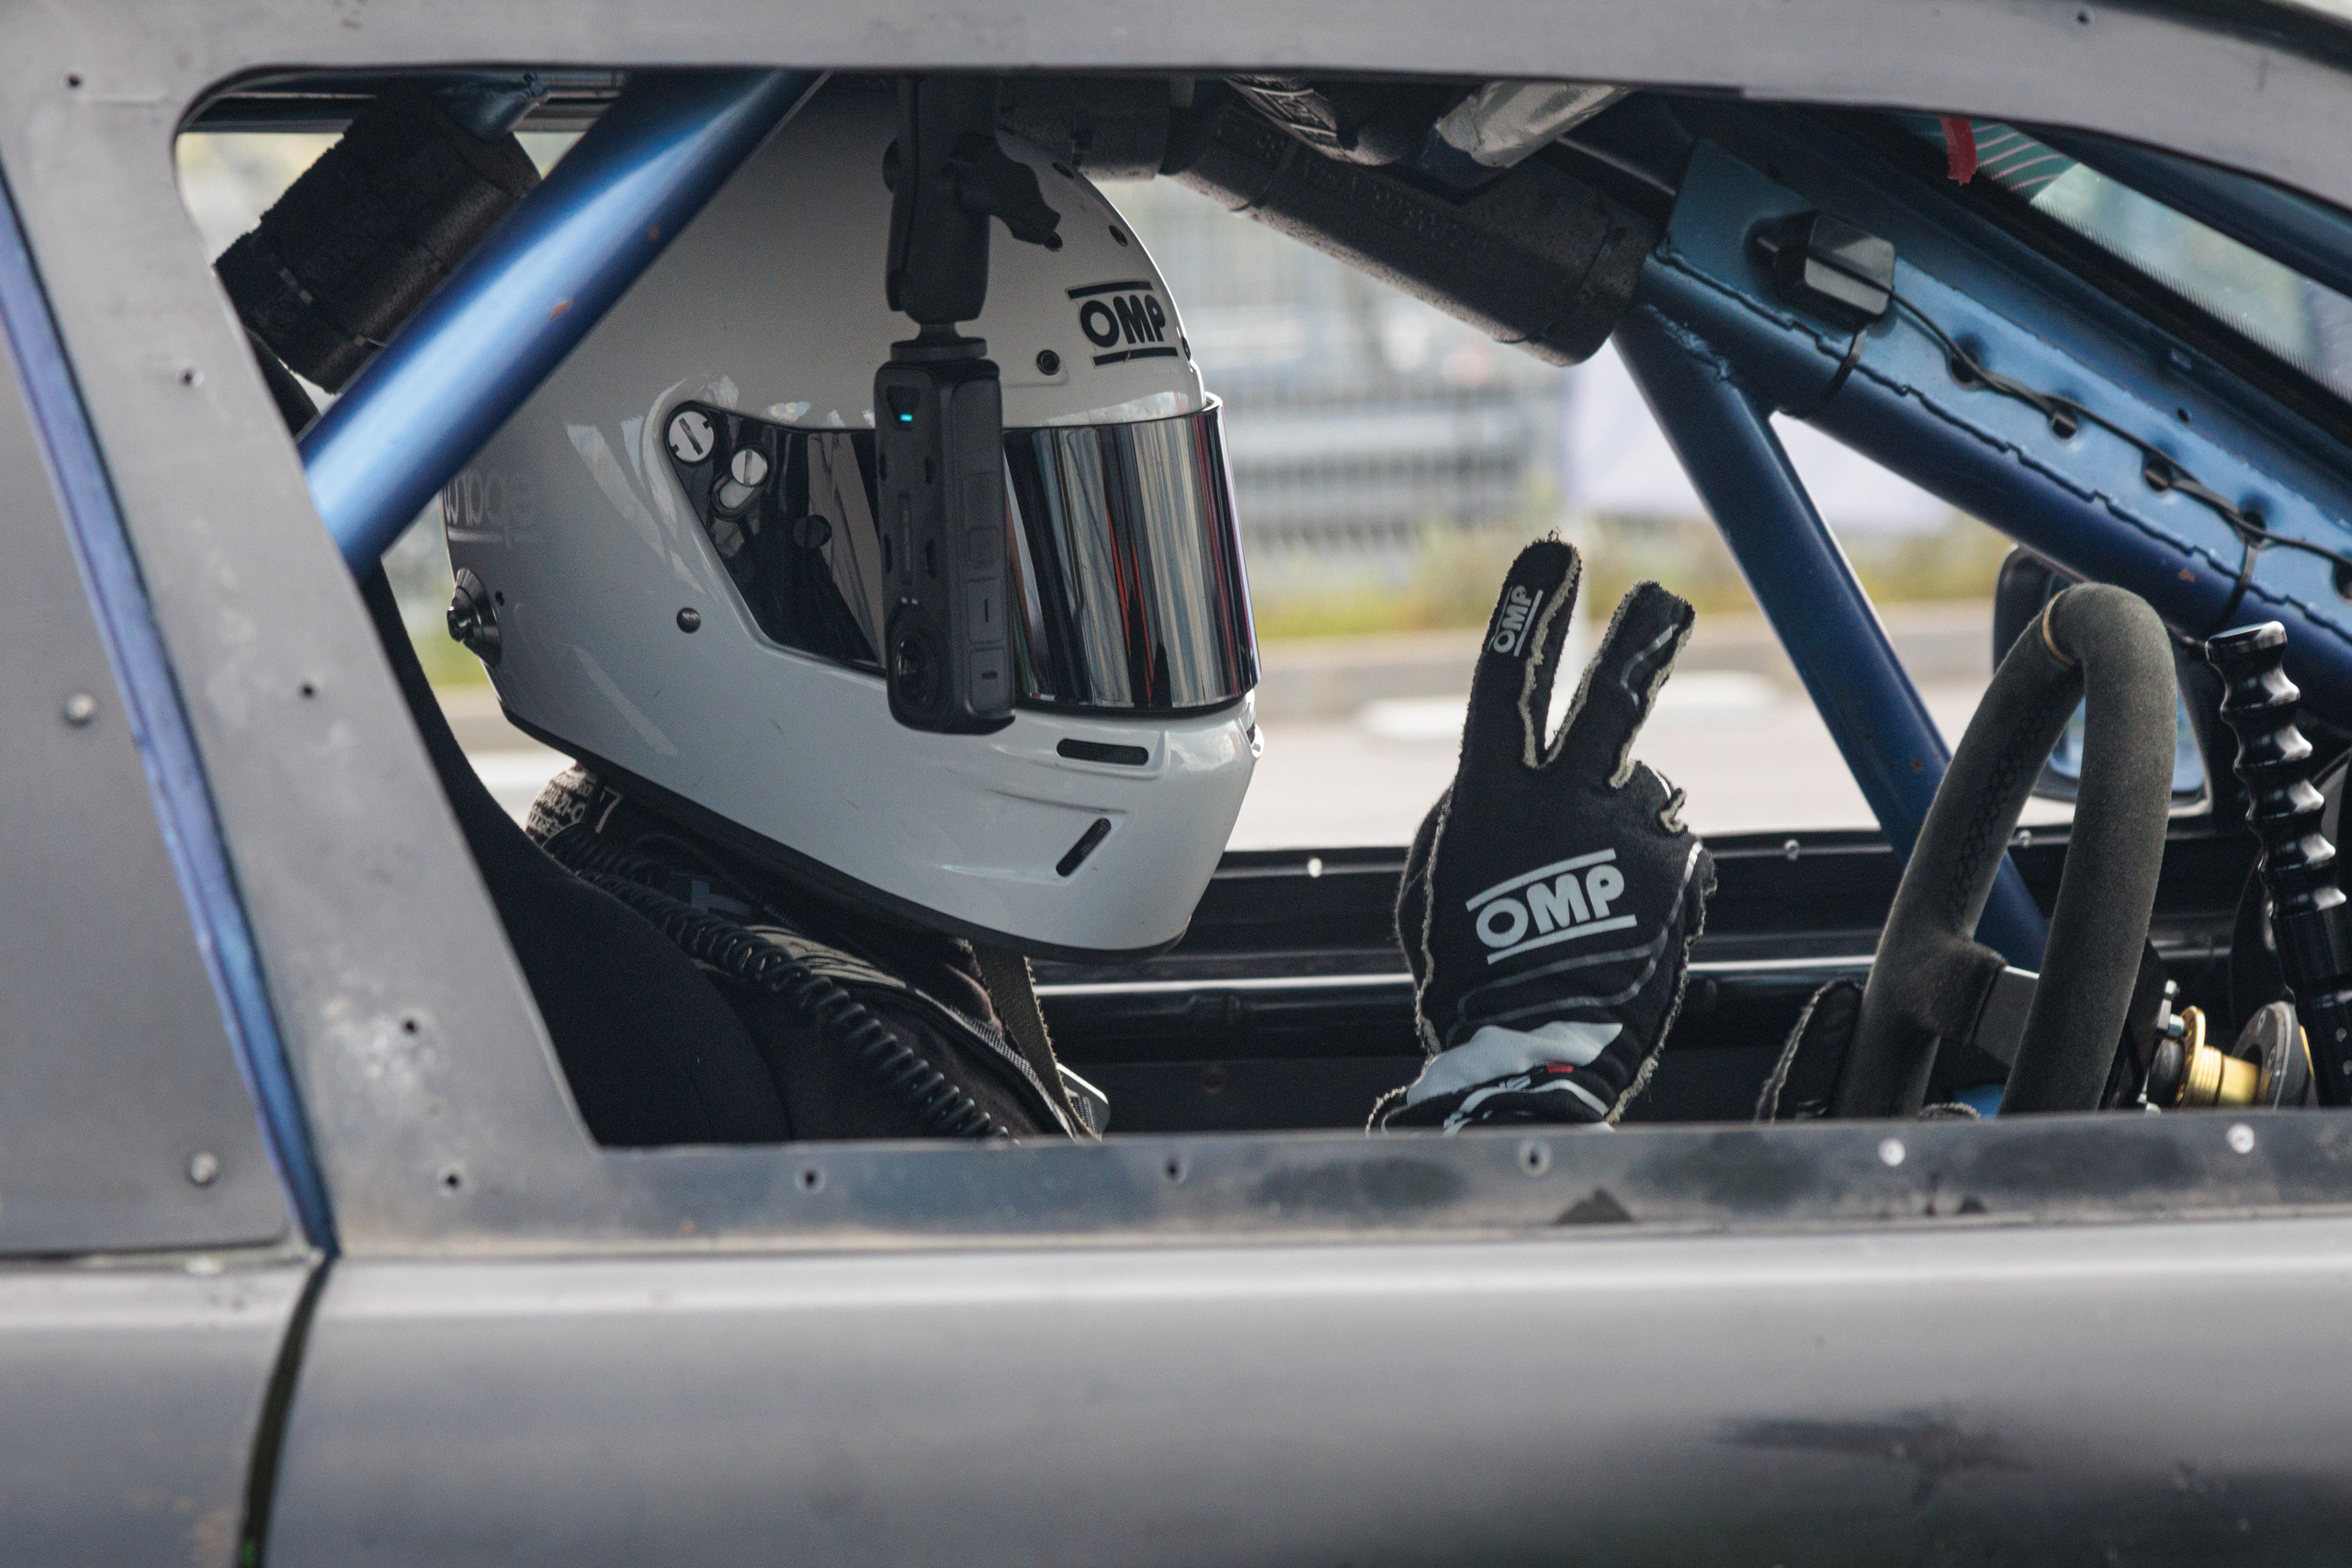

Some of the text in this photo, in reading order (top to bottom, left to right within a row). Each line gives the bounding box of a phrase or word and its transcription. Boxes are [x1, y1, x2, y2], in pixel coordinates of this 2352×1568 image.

[1080, 294, 1166, 348] OMP
[1493, 585, 1532, 653] OMP
[1476, 864, 1624, 948] OMP
